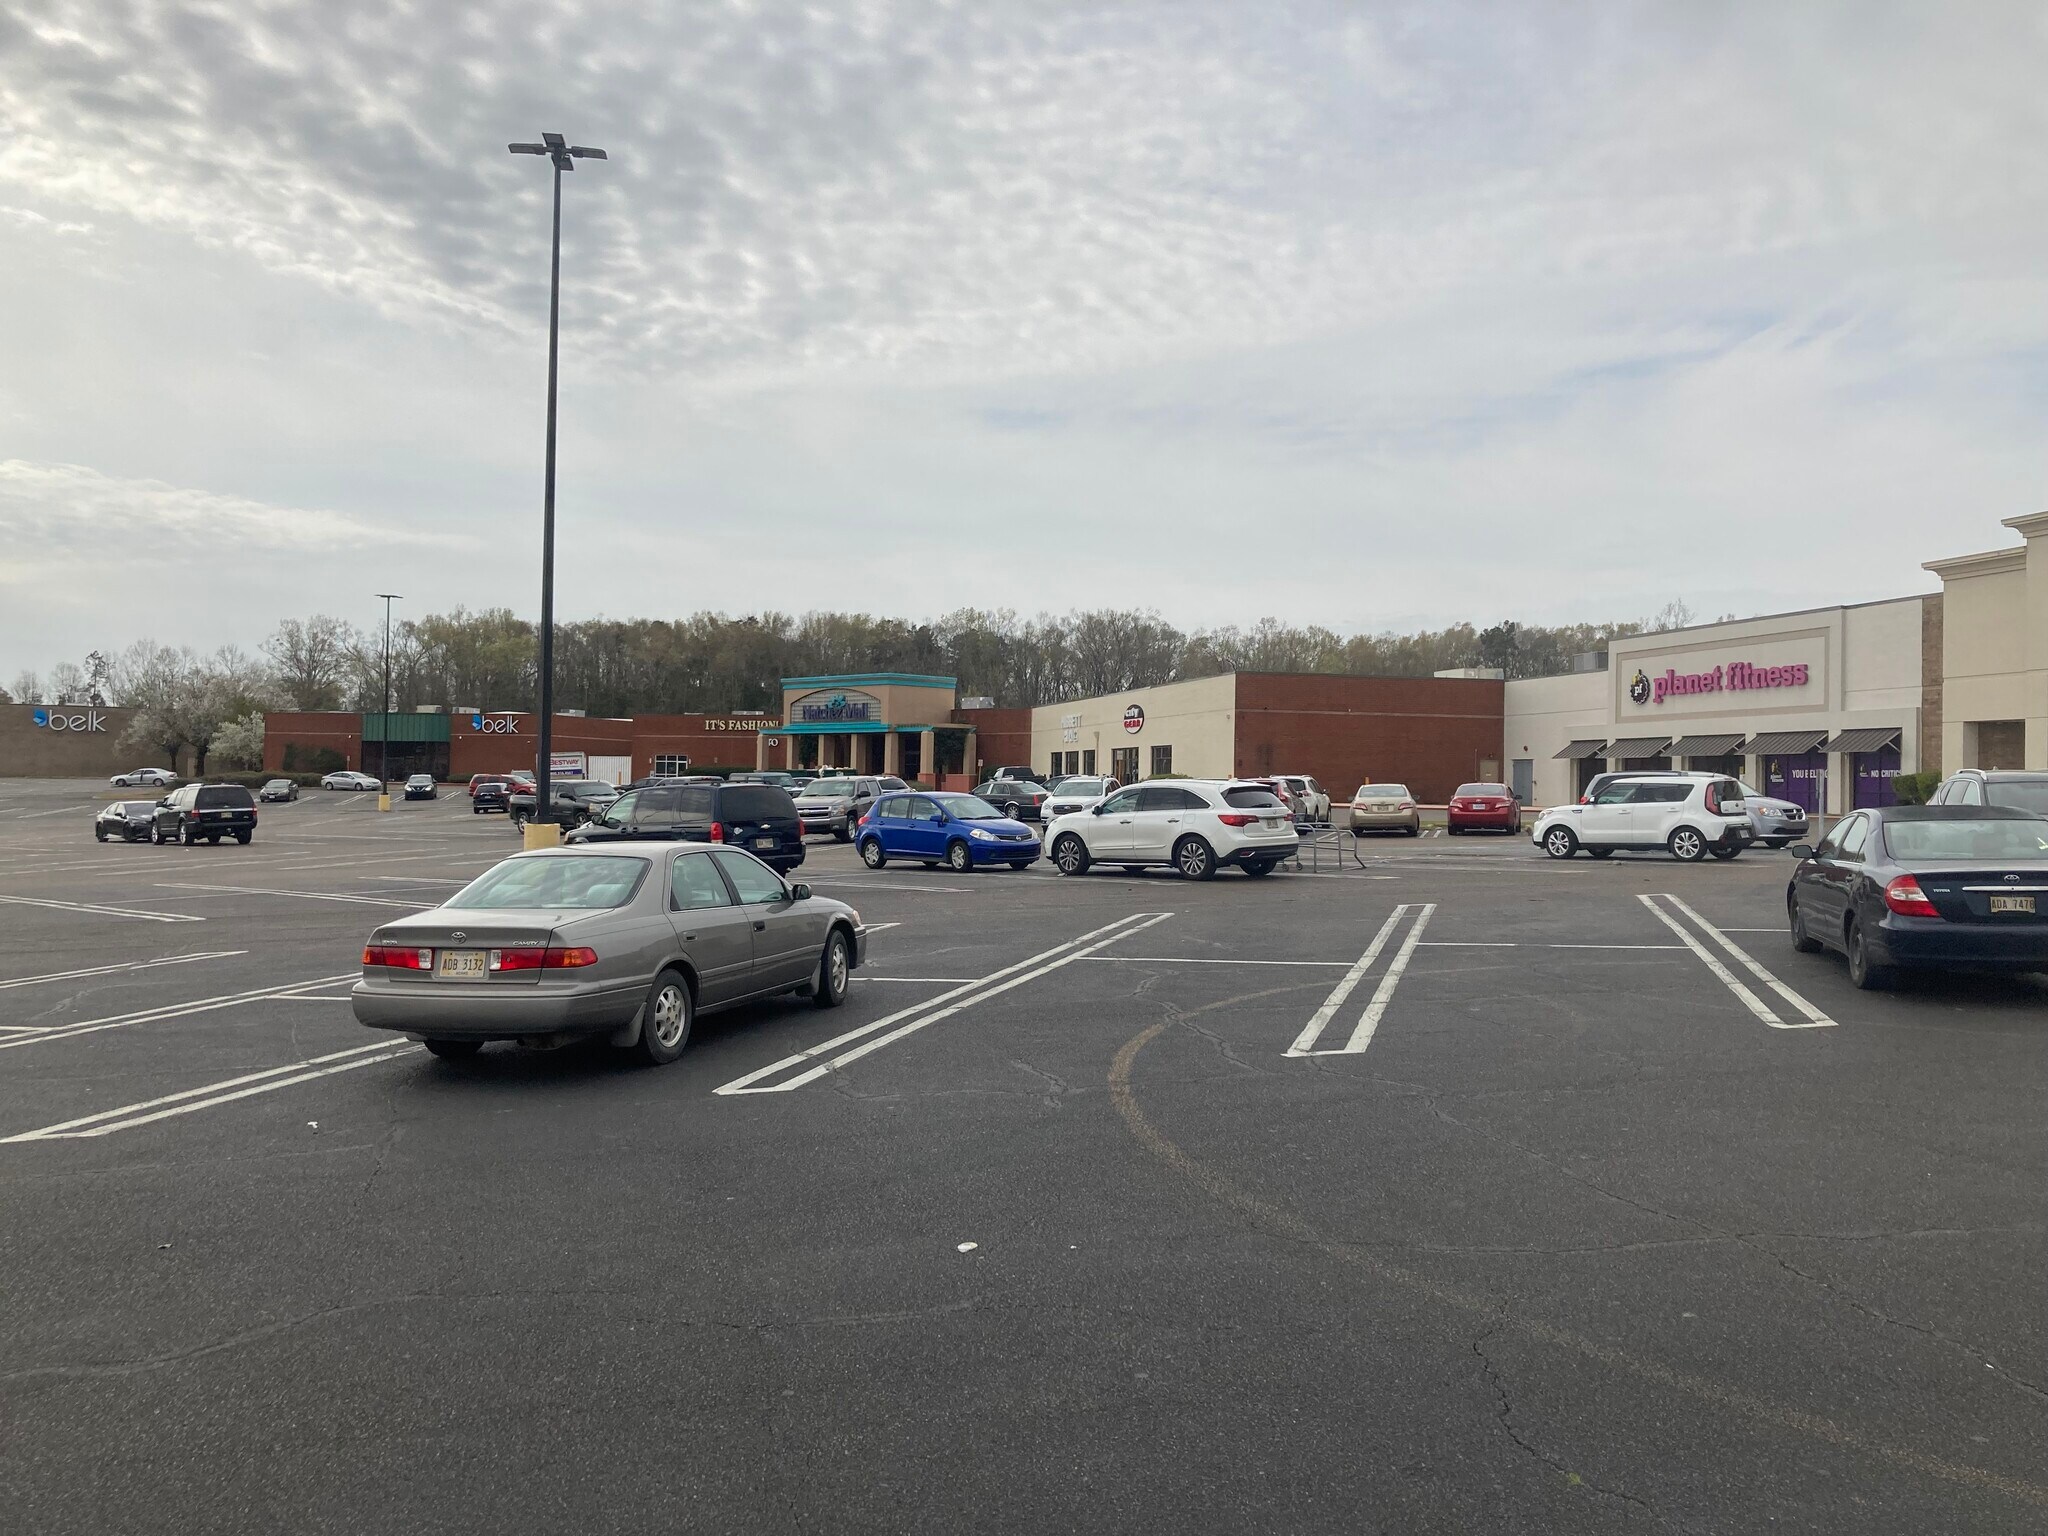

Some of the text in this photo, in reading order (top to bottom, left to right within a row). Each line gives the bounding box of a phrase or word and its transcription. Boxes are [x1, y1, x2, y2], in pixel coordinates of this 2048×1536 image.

[1653, 662, 1808, 703] planet fitness
[1634, 684, 1643, 696] pf
[48, 709, 107, 732] belk
[481, 715, 519, 733] belk
[705, 720, 726, 731] IT'S
[1792, 769, 1804, 778] YOU
[1870, 769, 1880, 778] NO
[1991, 900, 2008, 909] ADA
[442, 958, 484, 971] ADB 3132
